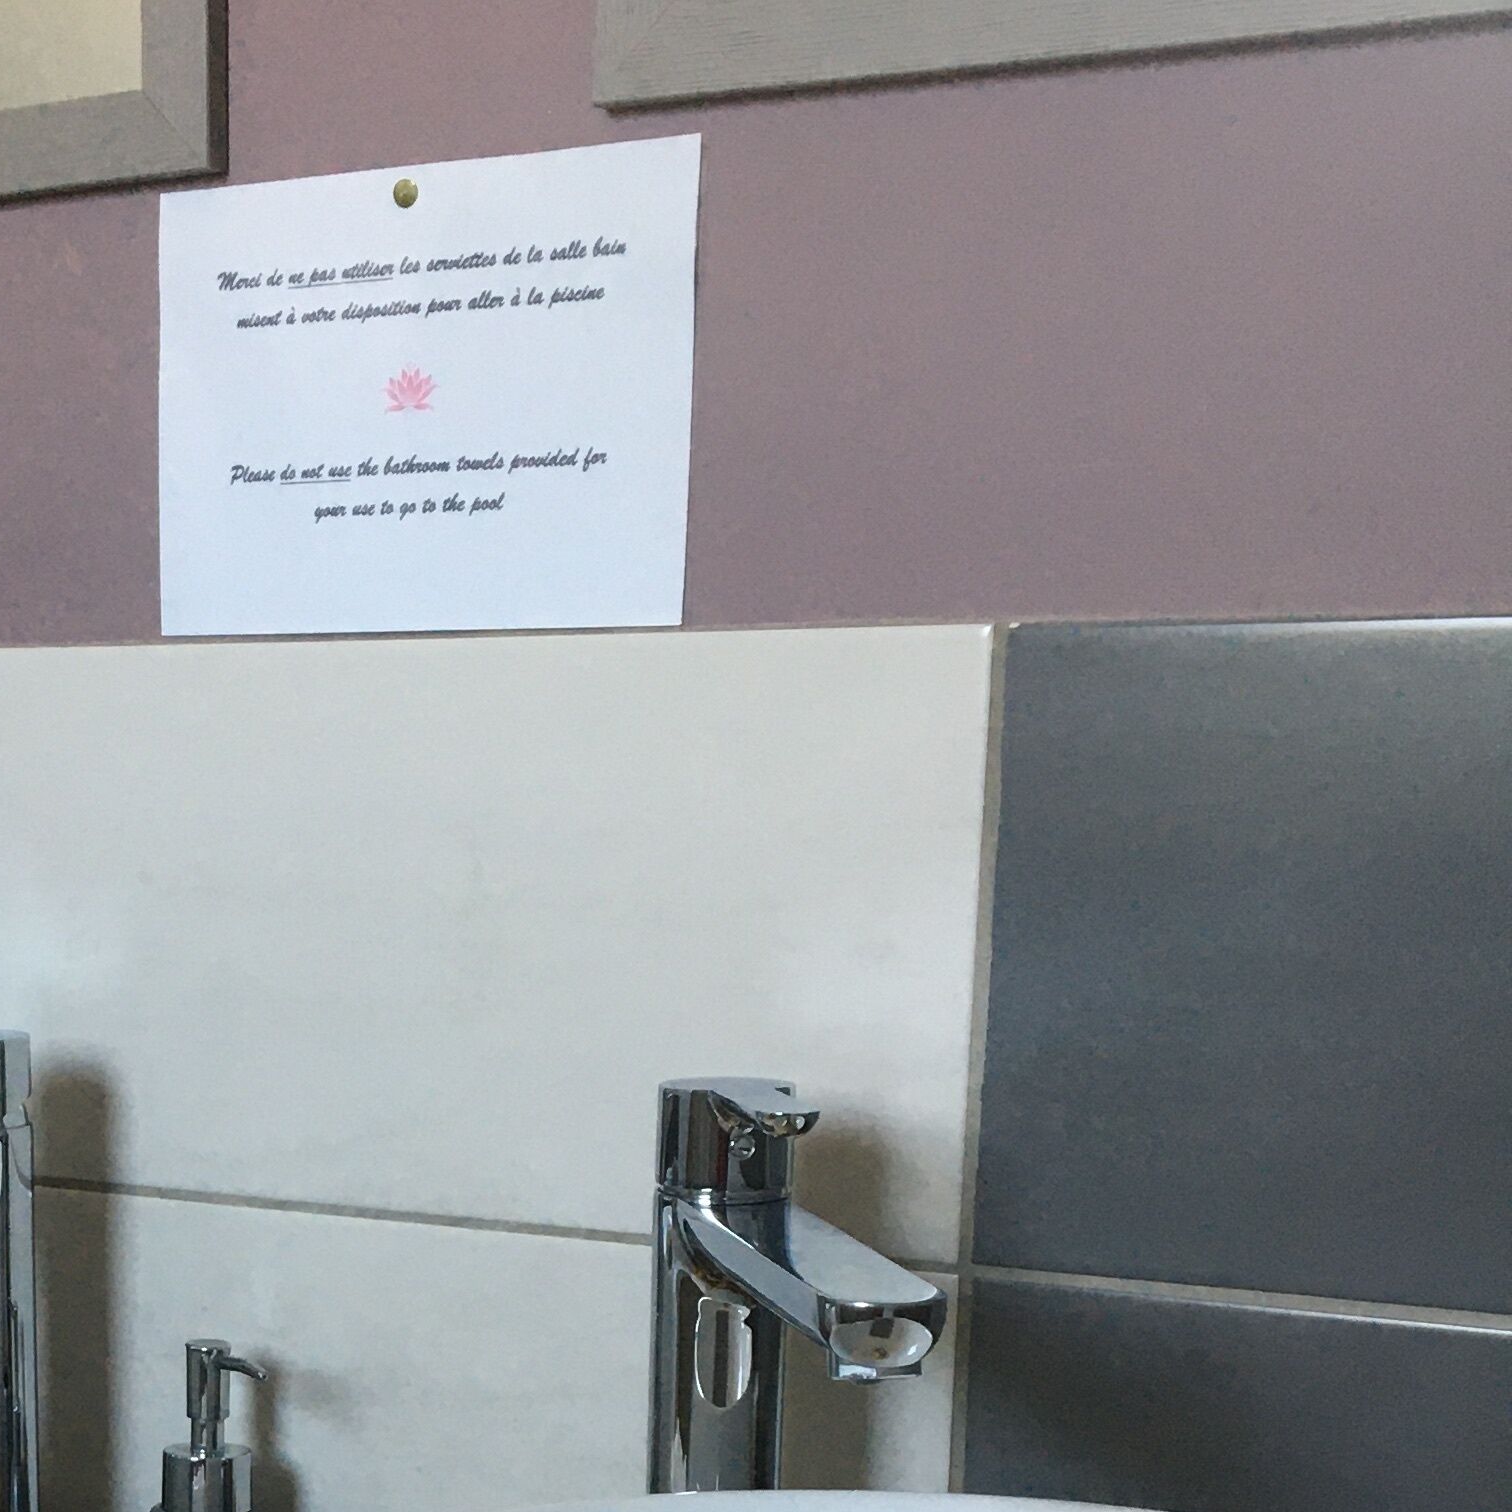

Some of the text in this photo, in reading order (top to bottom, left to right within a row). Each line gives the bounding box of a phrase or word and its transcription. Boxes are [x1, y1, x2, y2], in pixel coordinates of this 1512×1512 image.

[217, 236, 627, 291] Merci de ne pas utiliser les serviettes de la salle bain
[237, 285, 606, 329] misent à votre disposition pour aller à la piscine
[230, 446, 608, 485] Please do not use the bathroom towels provided for
[314, 491, 506, 524] your use to go to the pool
